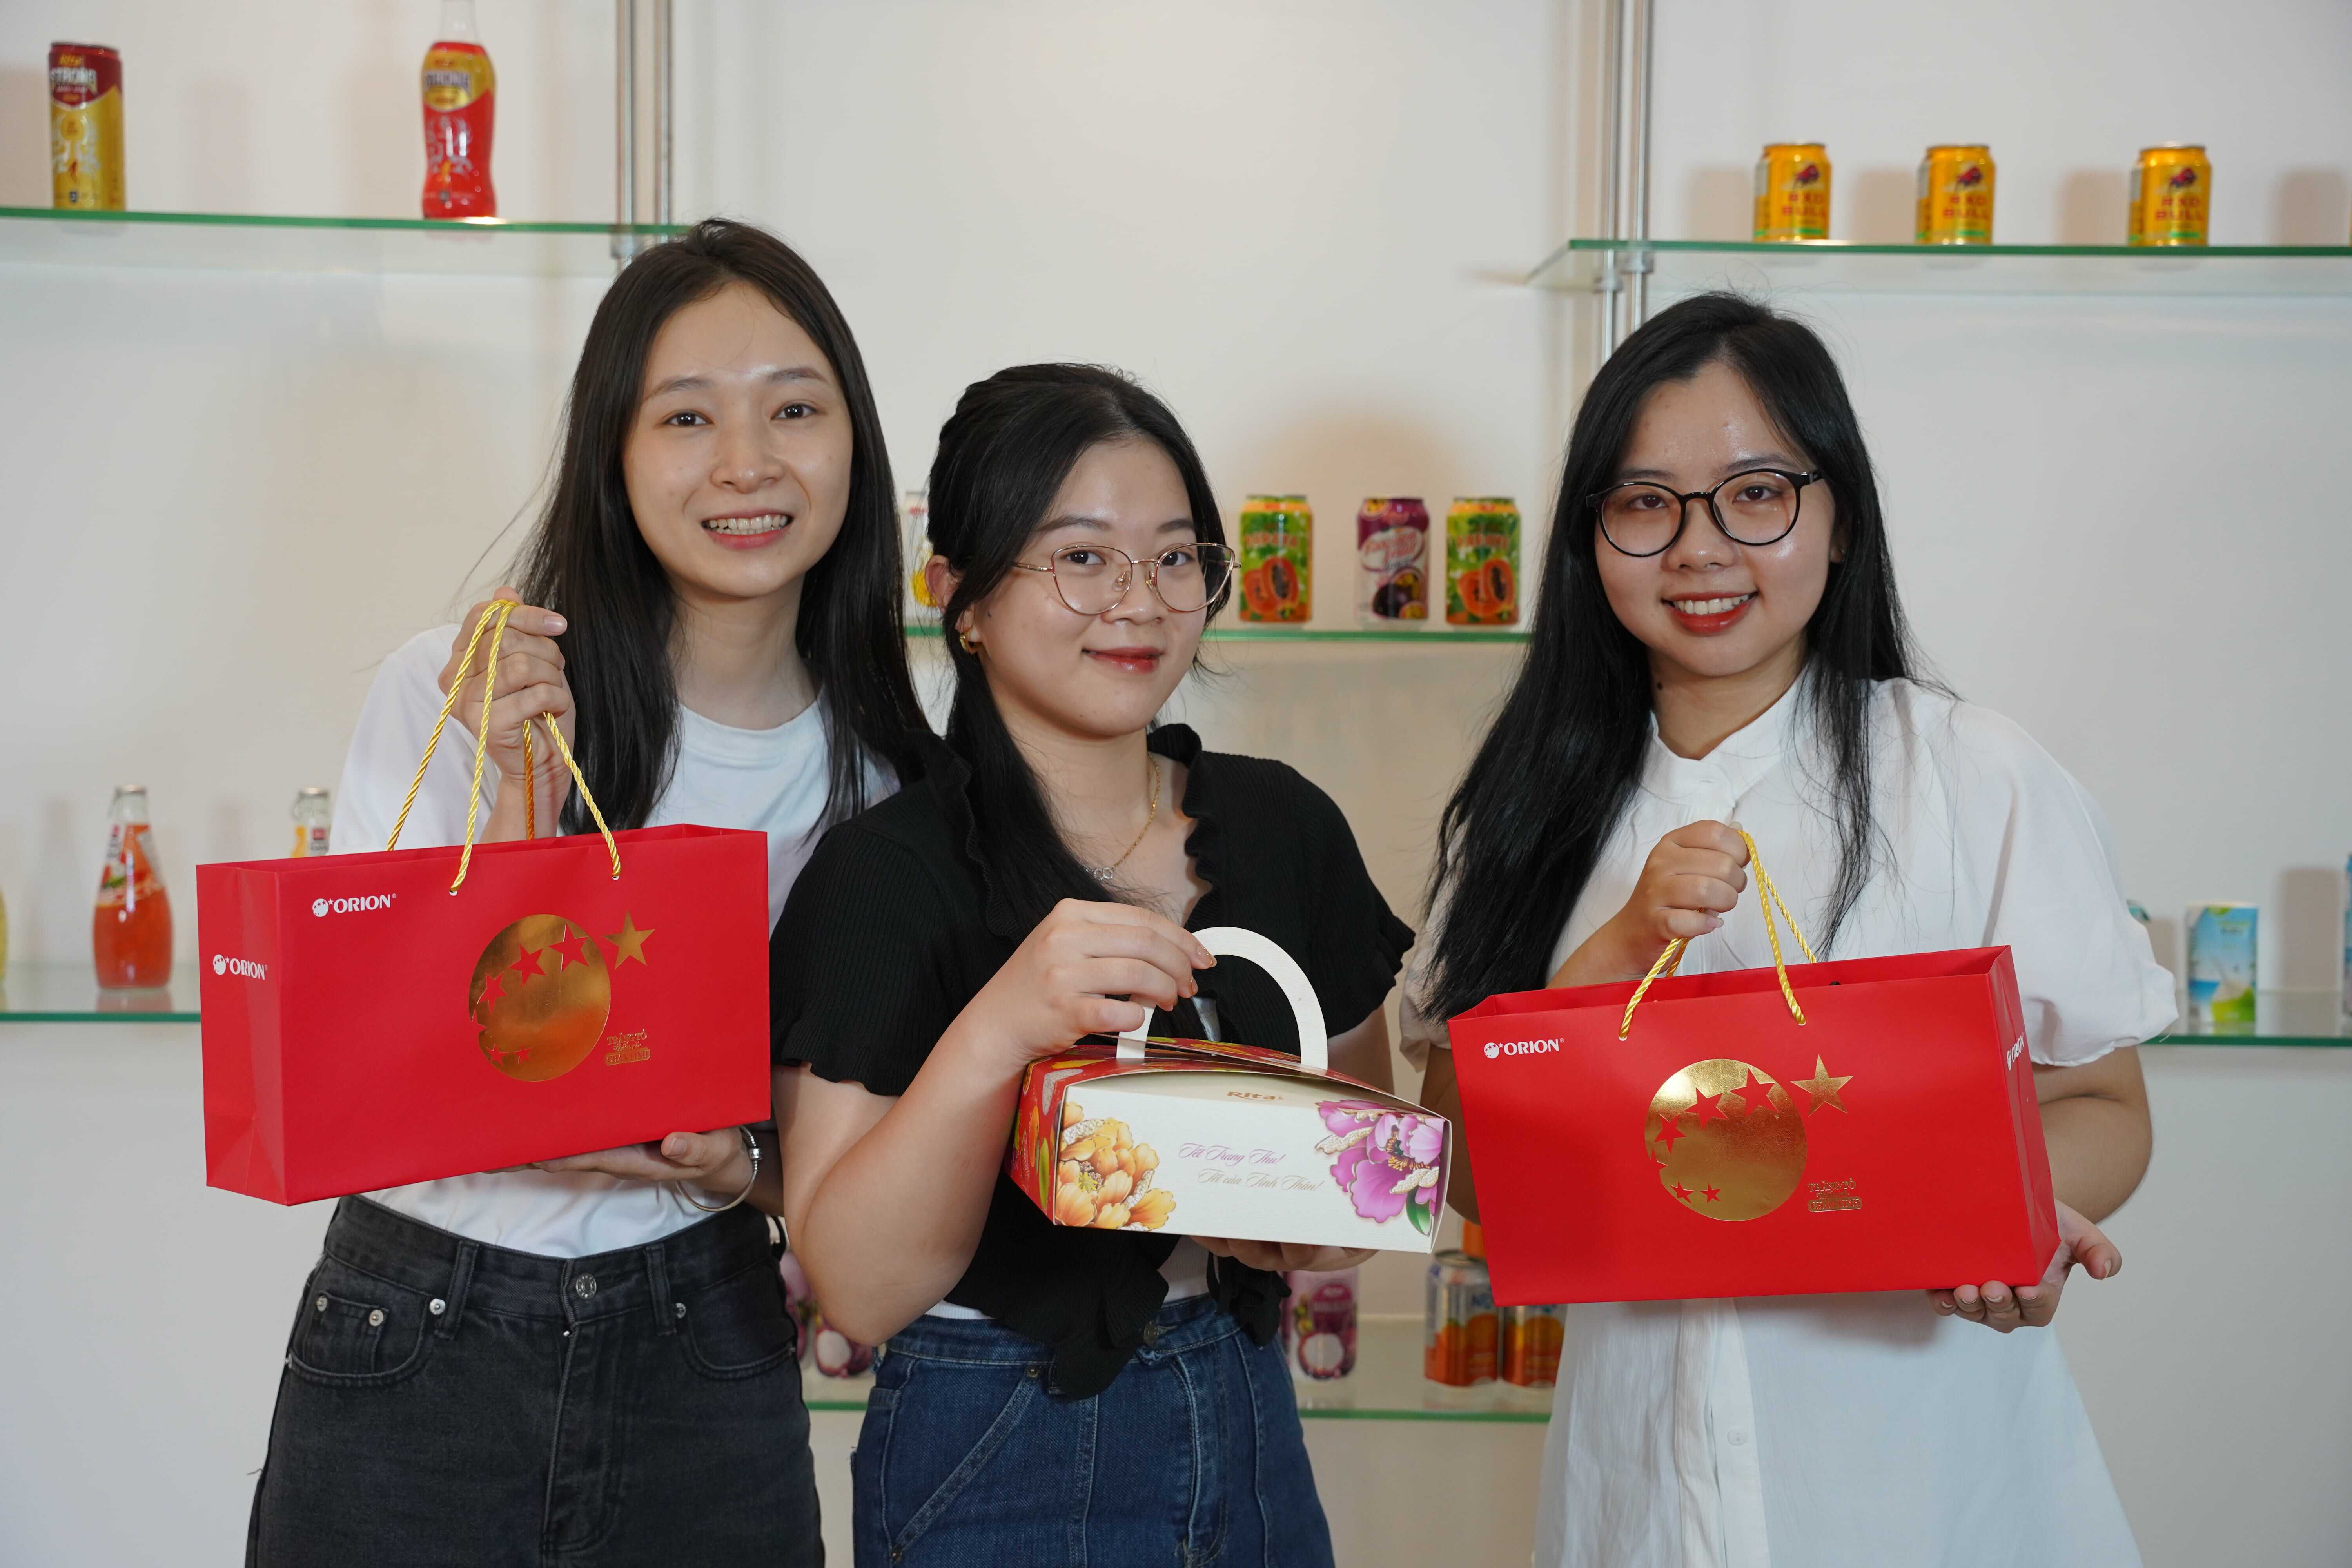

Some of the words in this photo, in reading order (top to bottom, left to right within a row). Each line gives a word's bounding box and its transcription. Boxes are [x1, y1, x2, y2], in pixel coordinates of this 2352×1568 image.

[333, 894, 390, 913] ORION
[229, 958, 265, 980] ORION
[1504, 1039, 1559, 1055] ORION
[1178, 1143, 1206, 1158] Tết
[1206, 1145, 1245, 1166] Trung
[1248, 1149, 1286, 1164] Thu!
[1198, 1168, 1224, 1183] Tết
[1222, 1175, 1242, 1184] của
[1245, 1172, 1279, 1187] Tình
[1281, 1175, 1325, 1191] Thân!
